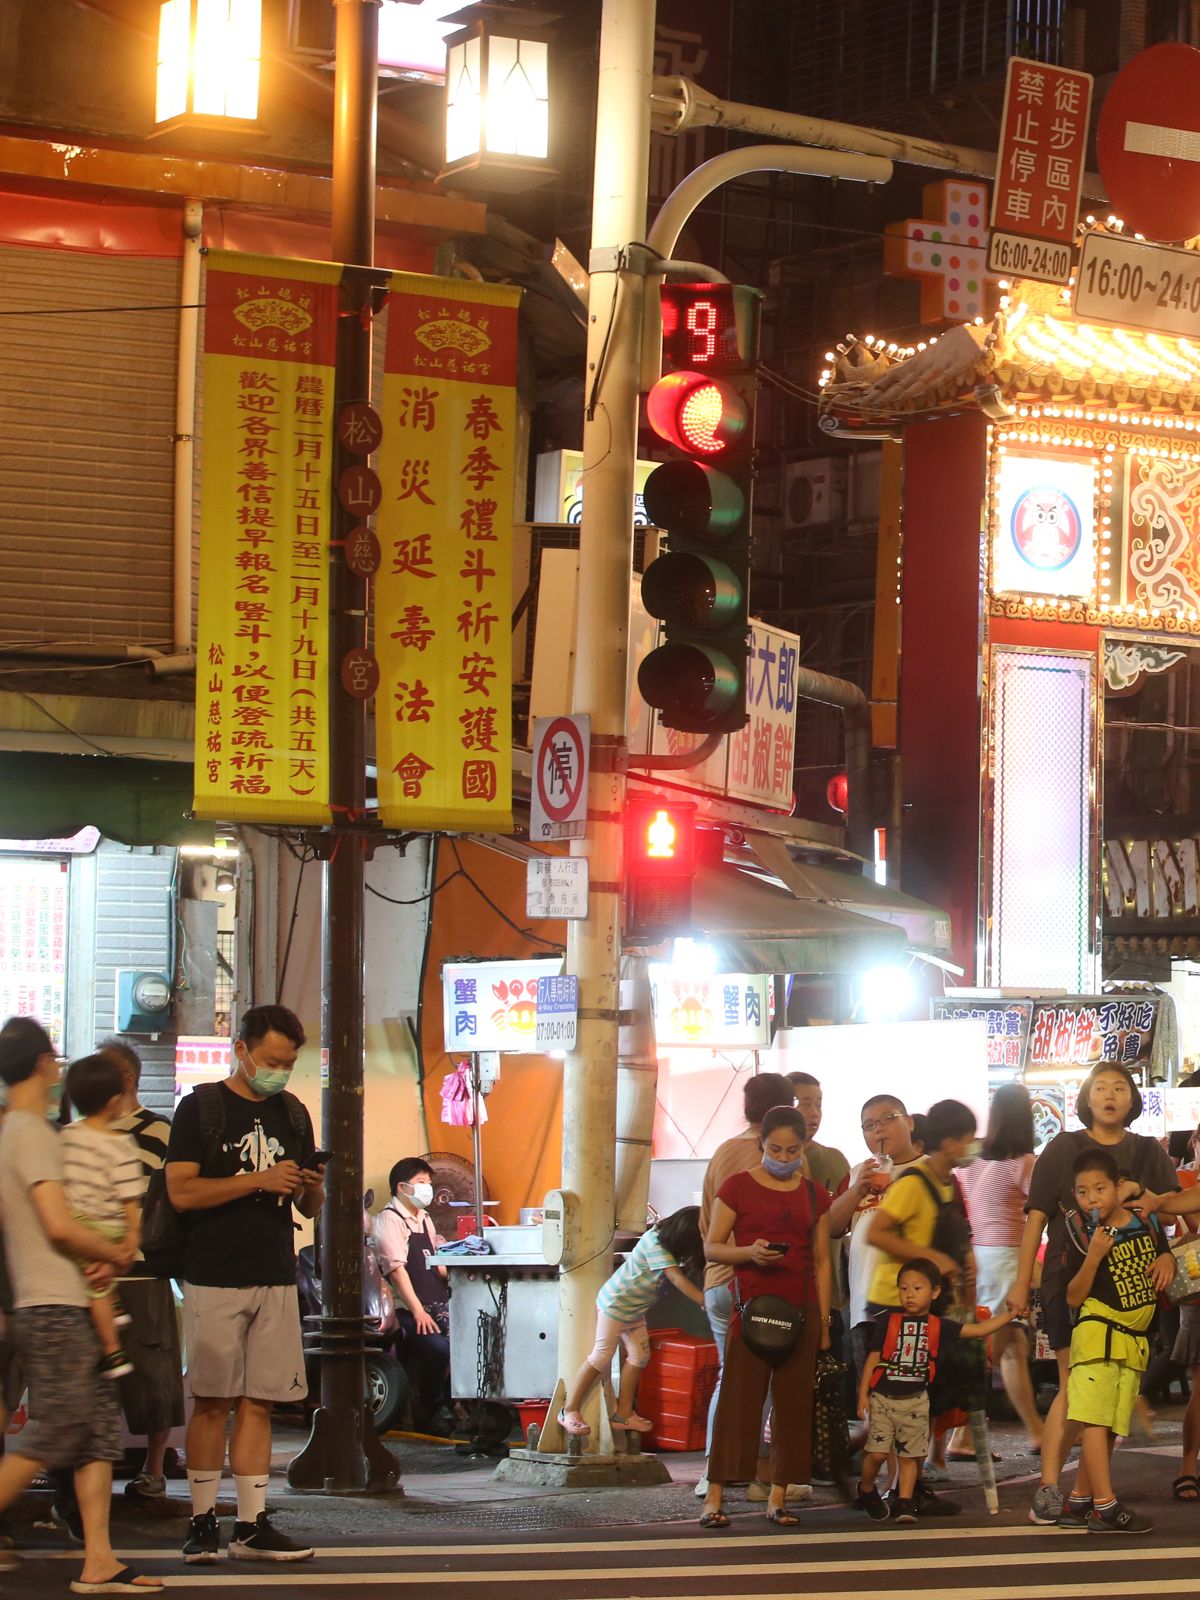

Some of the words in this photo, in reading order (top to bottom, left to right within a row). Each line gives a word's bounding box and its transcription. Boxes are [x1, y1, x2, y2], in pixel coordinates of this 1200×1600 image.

[1003, 69, 1045, 222] 禁止停車
[1041, 77, 1081, 231] 徒步區內
[994, 238, 1068, 278] 16:00-24:00
[687, 302, 716, 361] 9
[390, 386, 438, 800] 消災延壽法會
[456, 394, 503, 803] 春季禮斗祈安護國
[206, 642, 226, 784] 松山慈祐宮
[548, 741, 573, 795] 停
[537, 1021, 575, 1040] 07:00-01:00
[1032, 1008, 1096, 1062] 胡椒餅
[1099, 1002, 1154, 1033] 不好吃
[1102, 1034, 1140, 1062] 免費
